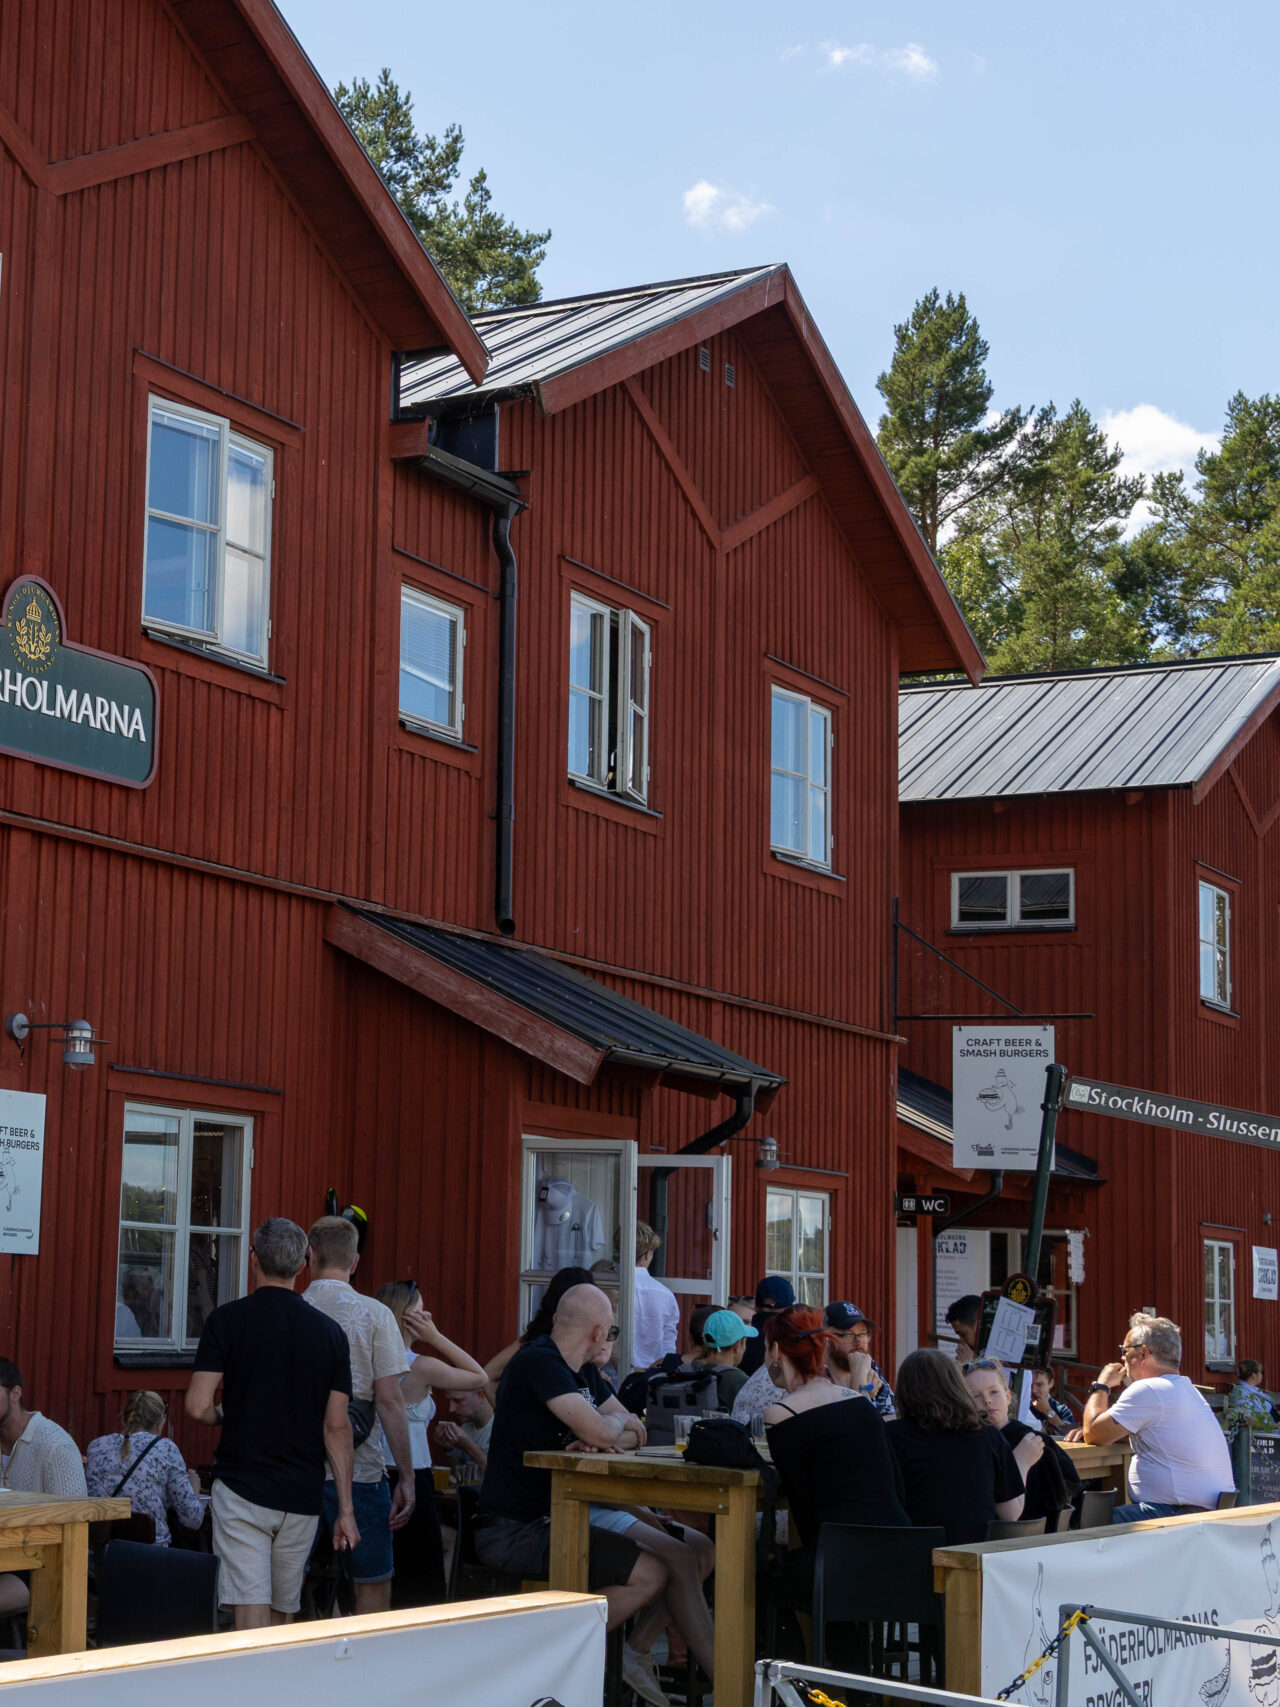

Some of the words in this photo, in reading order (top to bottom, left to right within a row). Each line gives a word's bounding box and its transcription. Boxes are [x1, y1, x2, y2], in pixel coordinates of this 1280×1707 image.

[966, 1038, 1002, 1047] CRAFT
[1004, 1038, 1032, 1047] BEER
[1034, 1038, 1042, 1047] &
[959, 1049, 997, 1058] SMASH
[999, 1049, 1049, 1058] BURGERS
[1089, 1088, 1194, 1125] Stockholm
[1206, 1112, 1280, 1142] Slussen
[9, 1127, 29, 1138] BEER
[29, 1129, 36, 1139] &
[6, 1139, 40, 1151] BURGERS
[921, 1199, 945, 1212] WC
[937, 1241, 967, 1254] KLAD
